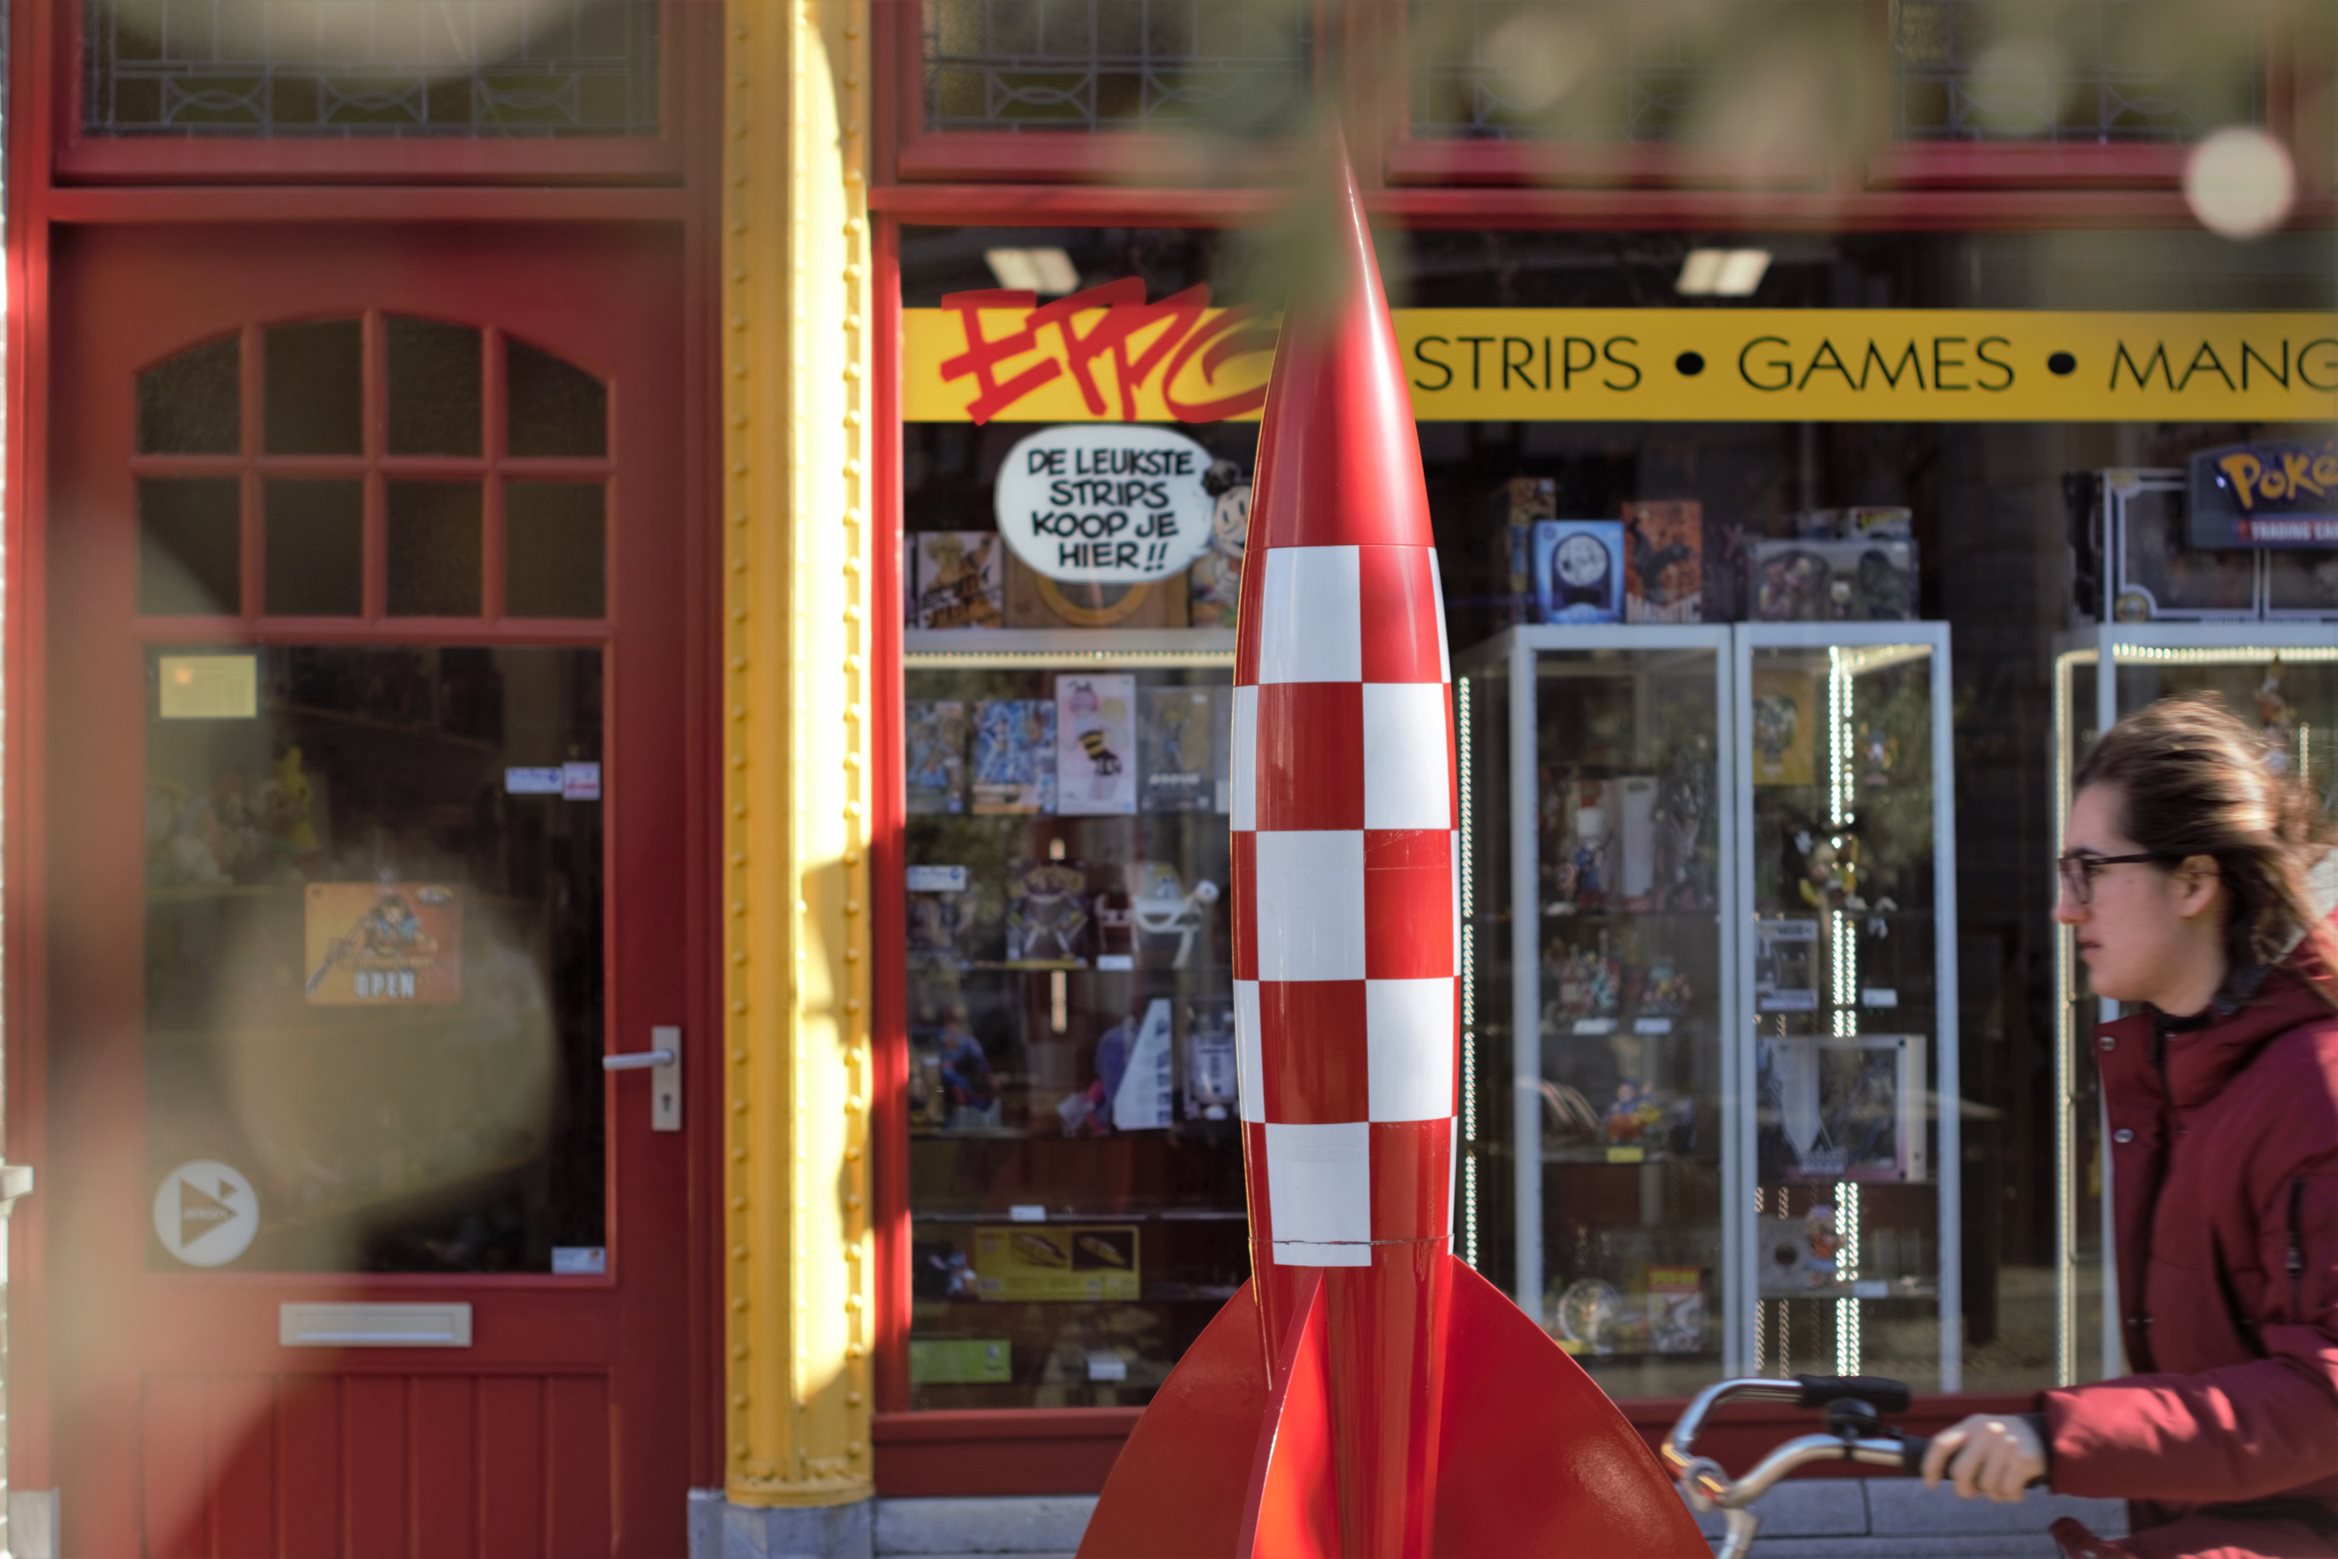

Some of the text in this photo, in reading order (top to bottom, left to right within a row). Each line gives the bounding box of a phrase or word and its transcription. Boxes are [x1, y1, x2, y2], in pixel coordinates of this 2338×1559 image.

[1413, 335, 1643, 392] STRIPS
[1738, 335, 2015, 392] GAMES
[1027, 448, 1195, 477] DE LEUKSTE
[1050, 479, 1170, 509] STRIPS
[1032, 510, 1179, 539] KOOP JE
[355, 970, 416, 999] OPEN
